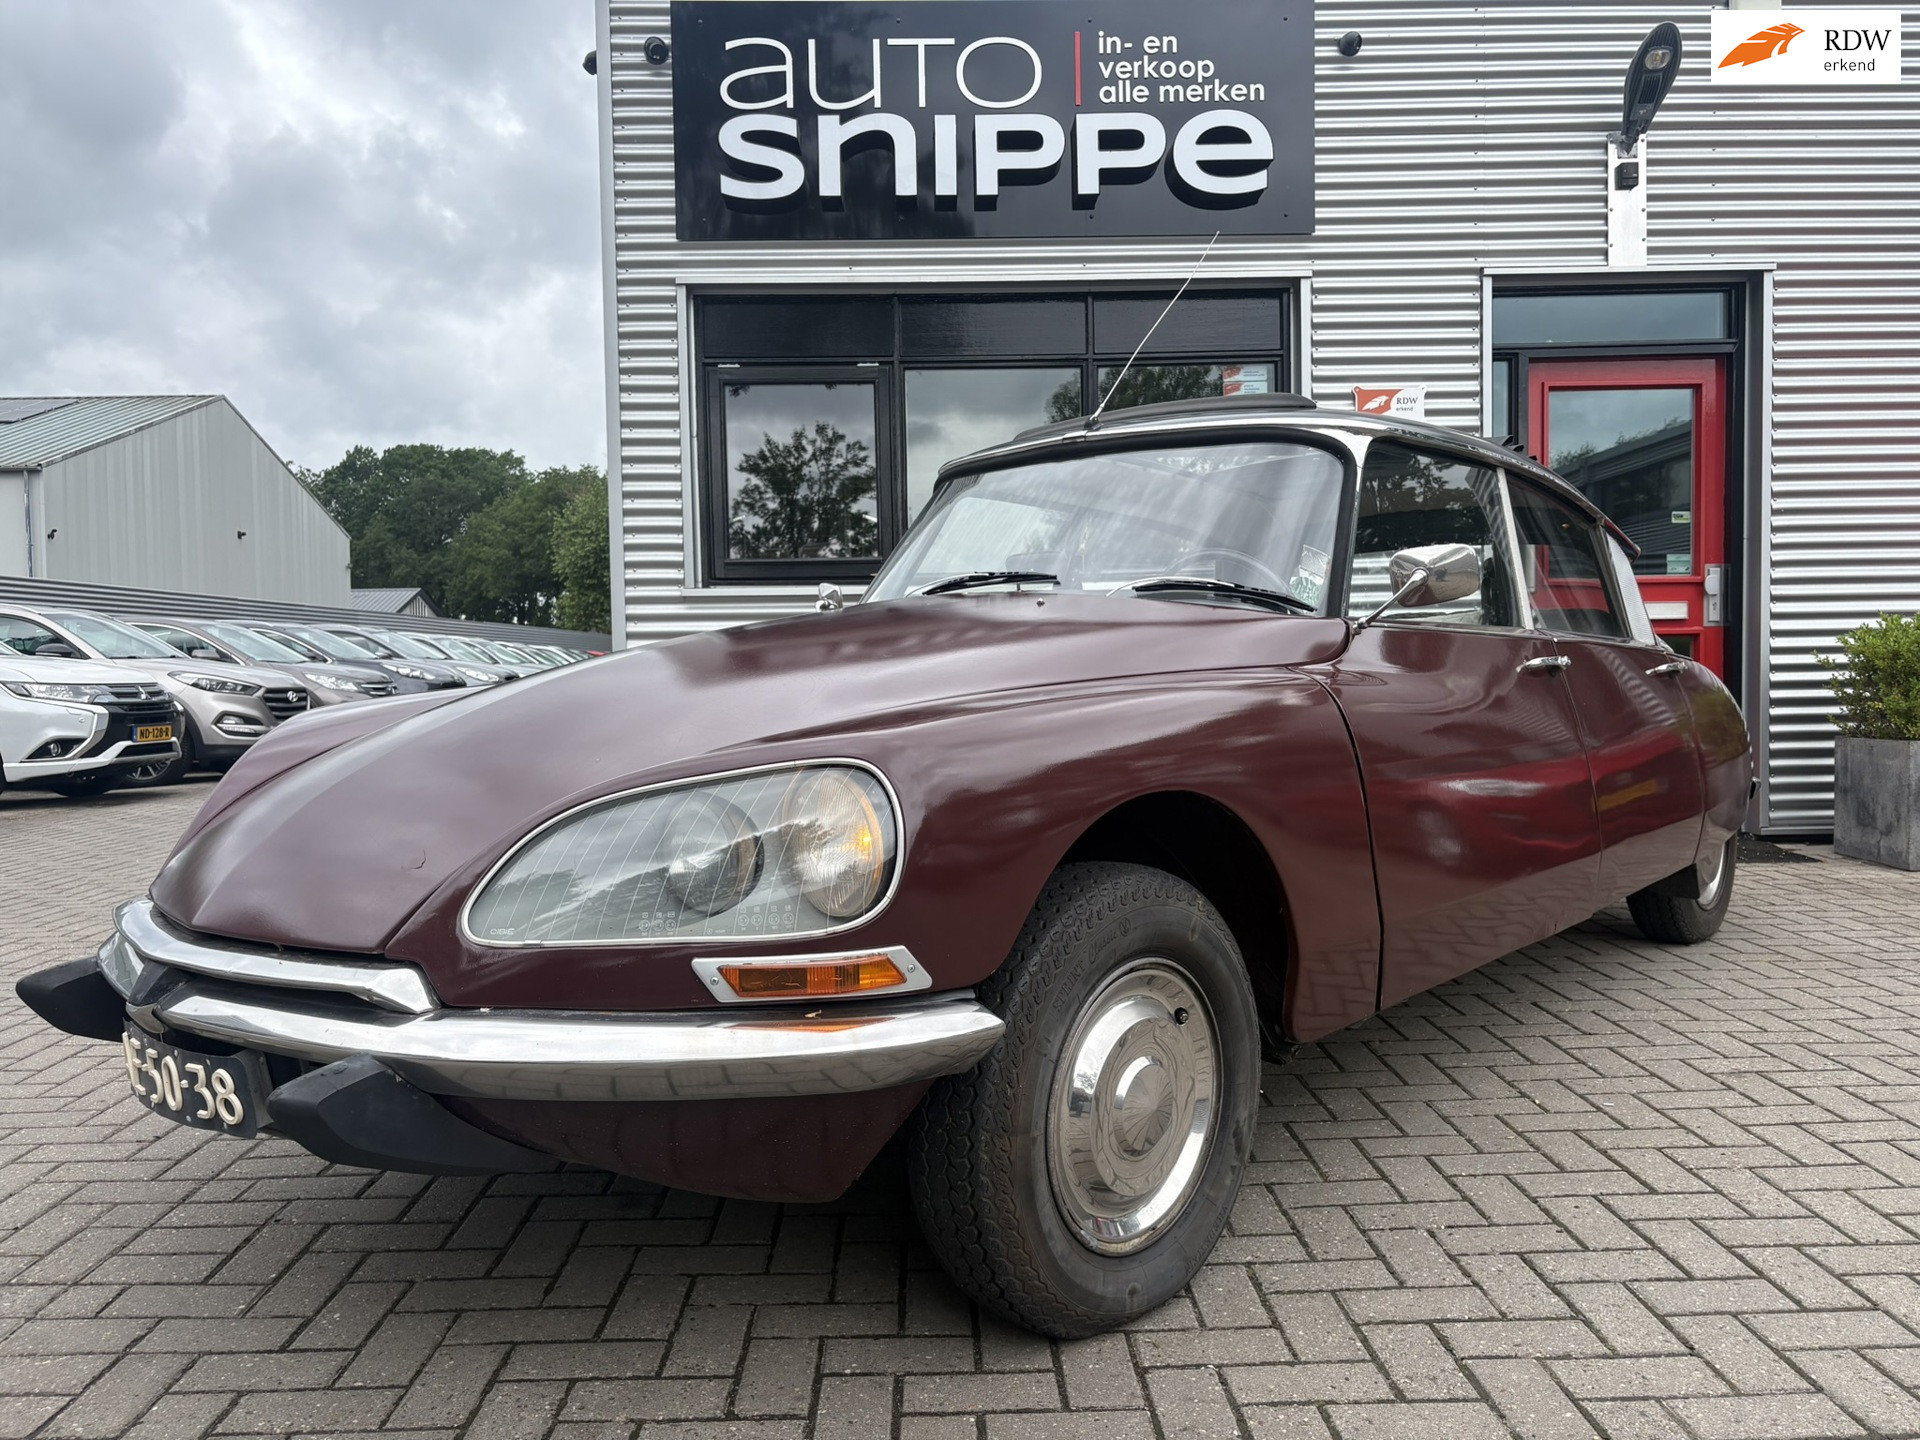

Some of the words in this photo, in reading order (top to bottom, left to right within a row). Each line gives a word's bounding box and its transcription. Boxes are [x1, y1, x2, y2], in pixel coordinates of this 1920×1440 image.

[1097, 30, 1133, 54] in-
[1142, 35, 1178, 54] en
[1098, 54, 1215, 84] verkoop
[1098, 79, 1149, 104] alle
[1158, 79, 1265, 103] merken
[1396, 397, 1418, 405] RDW
[122, 1031, 245, 1126] E-50-38
